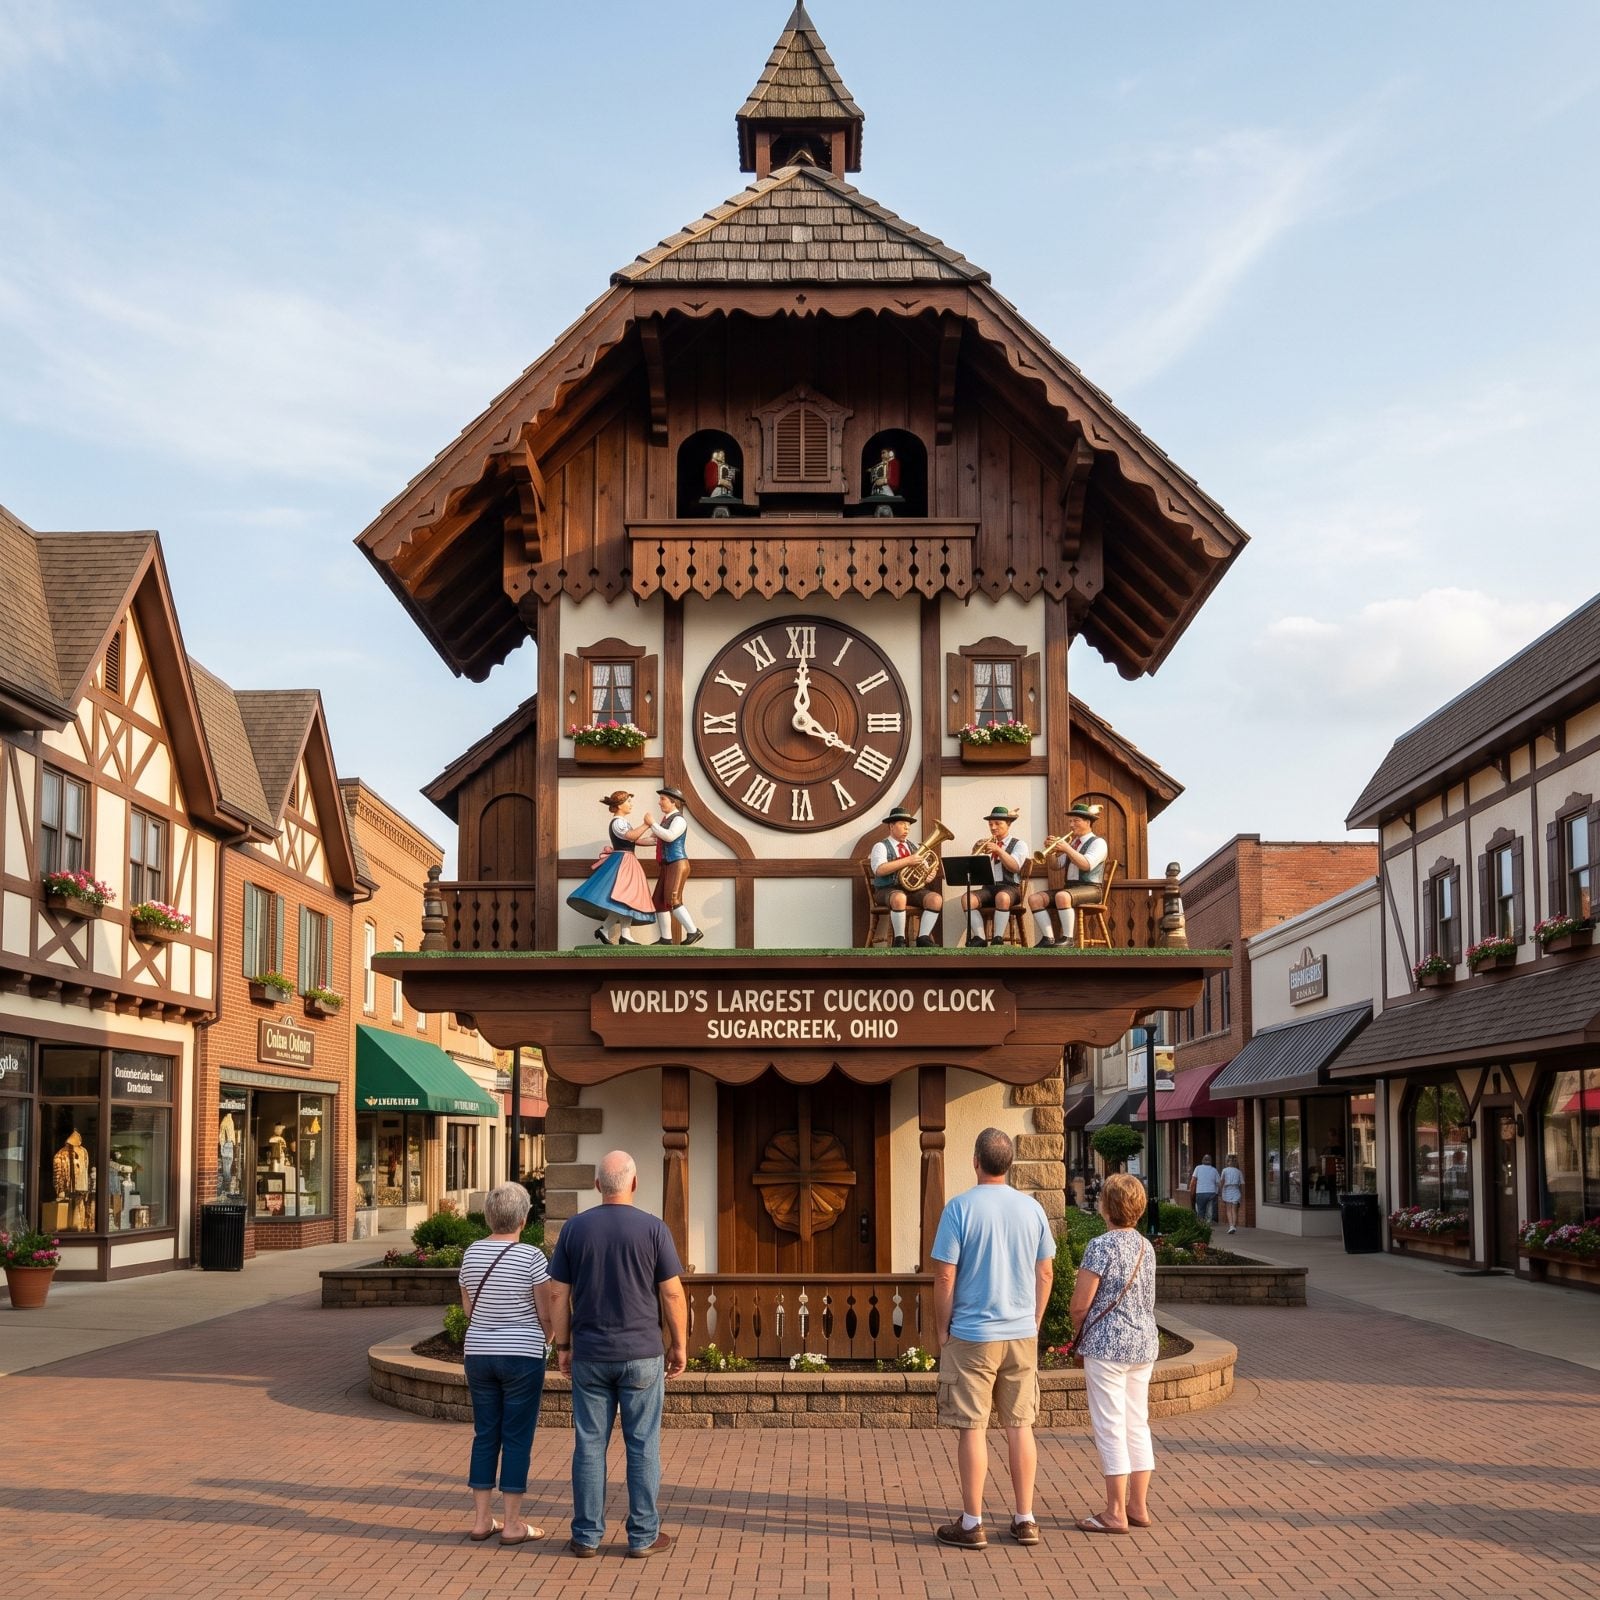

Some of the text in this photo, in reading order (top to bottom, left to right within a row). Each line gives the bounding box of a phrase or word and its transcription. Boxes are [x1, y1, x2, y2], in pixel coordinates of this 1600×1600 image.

[742, 635, 776, 671] XI
[786, 627, 816, 658] XII
[714, 669, 747, 696] X
[855, 669, 889, 695] II
[703, 711, 737, 735] IX
[867, 712, 901, 733] III
[710, 743, 751, 788] VIII
[741, 774, 777, 814] VII
[791, 789, 815, 821] VI
[832, 779, 857, 811] V
[609, 989, 996, 1013] WORLD'S LARGEST CUCKOO CLOCK
[706, 1018, 899, 1042] SUGARCREEK, OHIO
